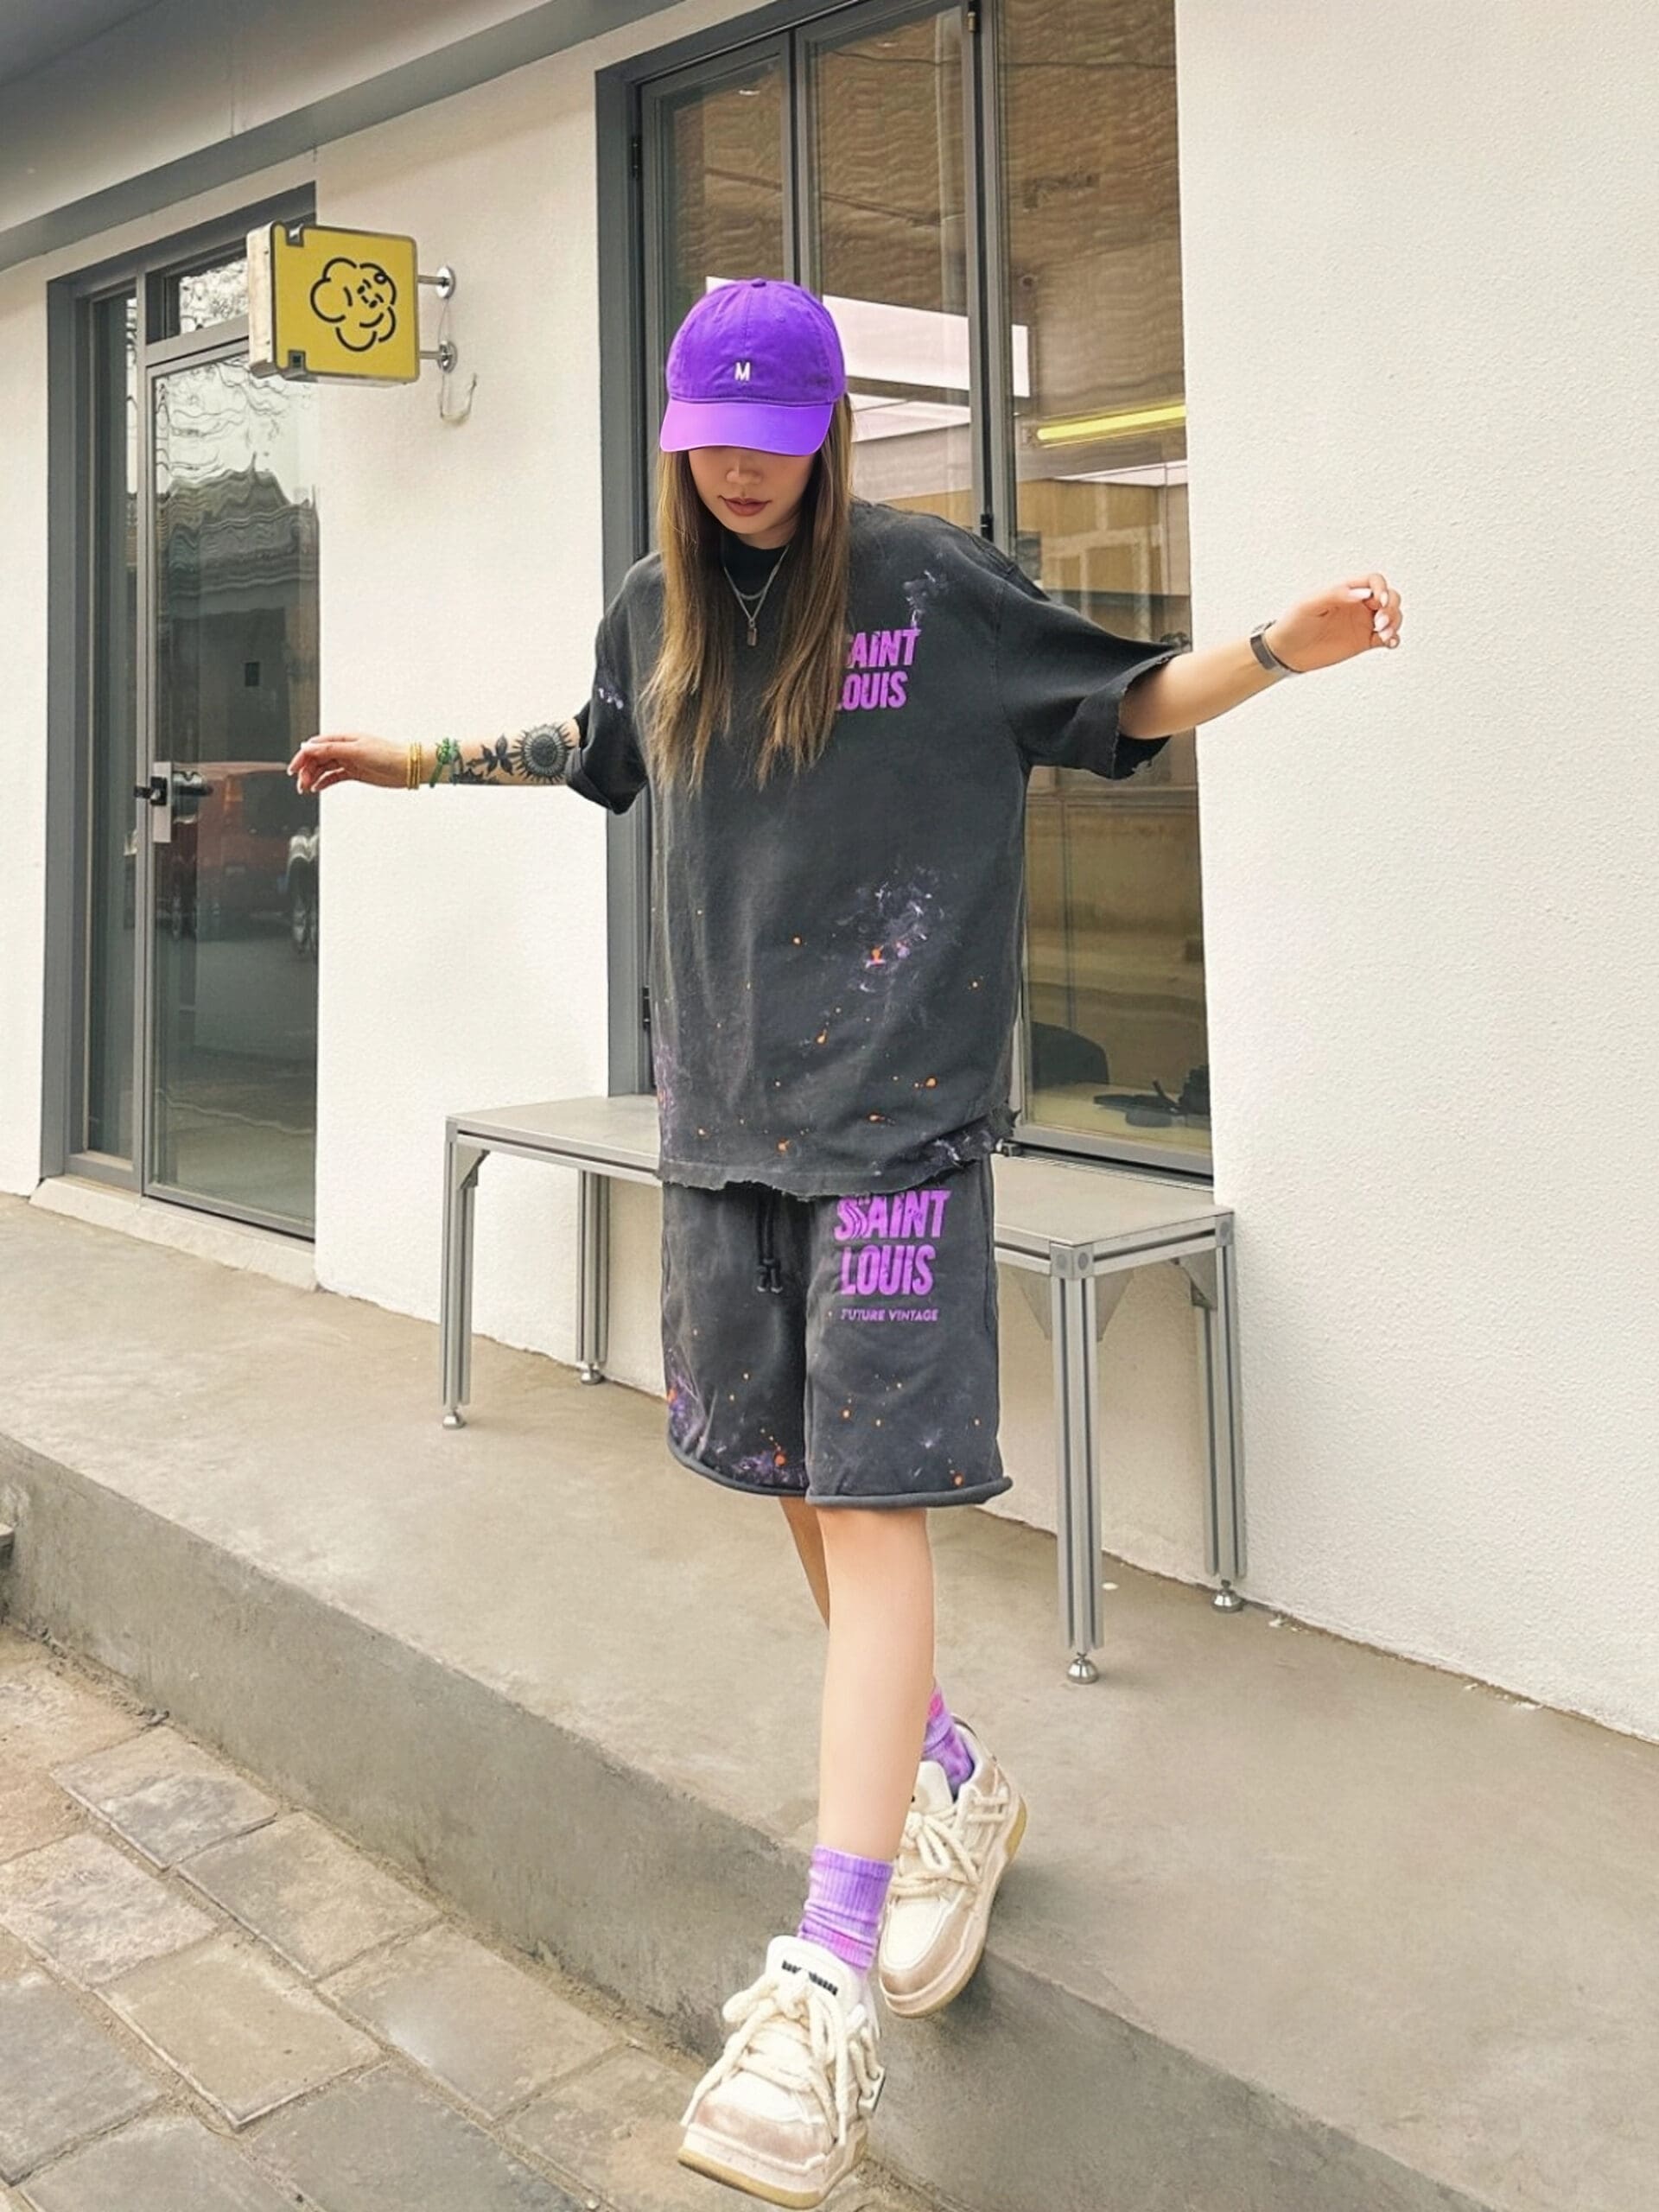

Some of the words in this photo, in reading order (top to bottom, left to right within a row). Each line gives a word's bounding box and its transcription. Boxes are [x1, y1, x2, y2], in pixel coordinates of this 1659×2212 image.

[734, 362, 750, 381] M
[846, 629, 922, 669] AINT
[836, 671, 908, 711] OUIS
[840, 1244, 936, 1295] LOUIS
[841, 1308, 885, 1321] FUTURE
[889, 1308, 939, 1321] VINTAGE
